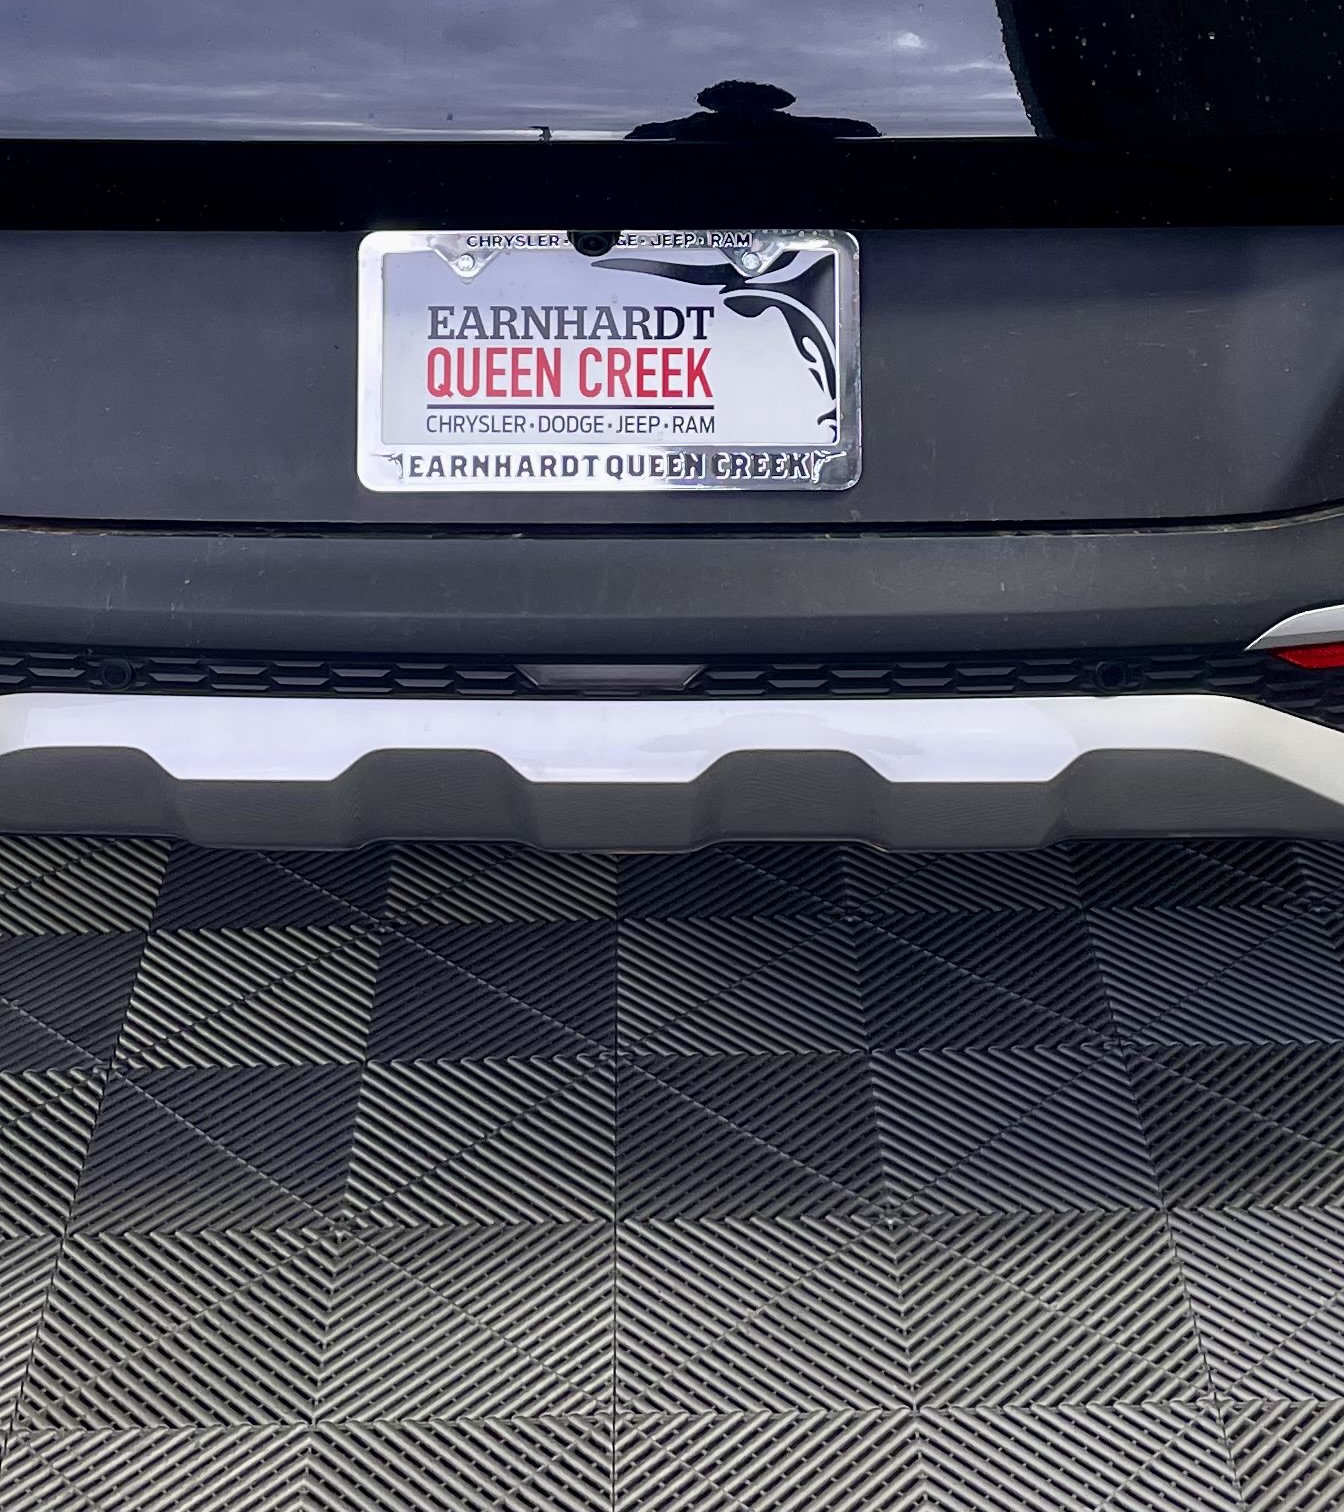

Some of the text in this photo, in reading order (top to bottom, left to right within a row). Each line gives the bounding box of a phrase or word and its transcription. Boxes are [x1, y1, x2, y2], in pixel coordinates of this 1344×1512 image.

[466, 235, 560, 247] CHRYSLER
[651, 234, 695, 248] JEEP
[711, 233, 754, 247] RAM
[427, 305, 715, 340] EARNHARDT
[427, 347, 713, 398] QUEEN CREEK
[426, 414, 716, 434] CHRYSLER DODGE JEEP RAM
[407, 452, 812, 479] EARNHARDT QUEEN CREEK
